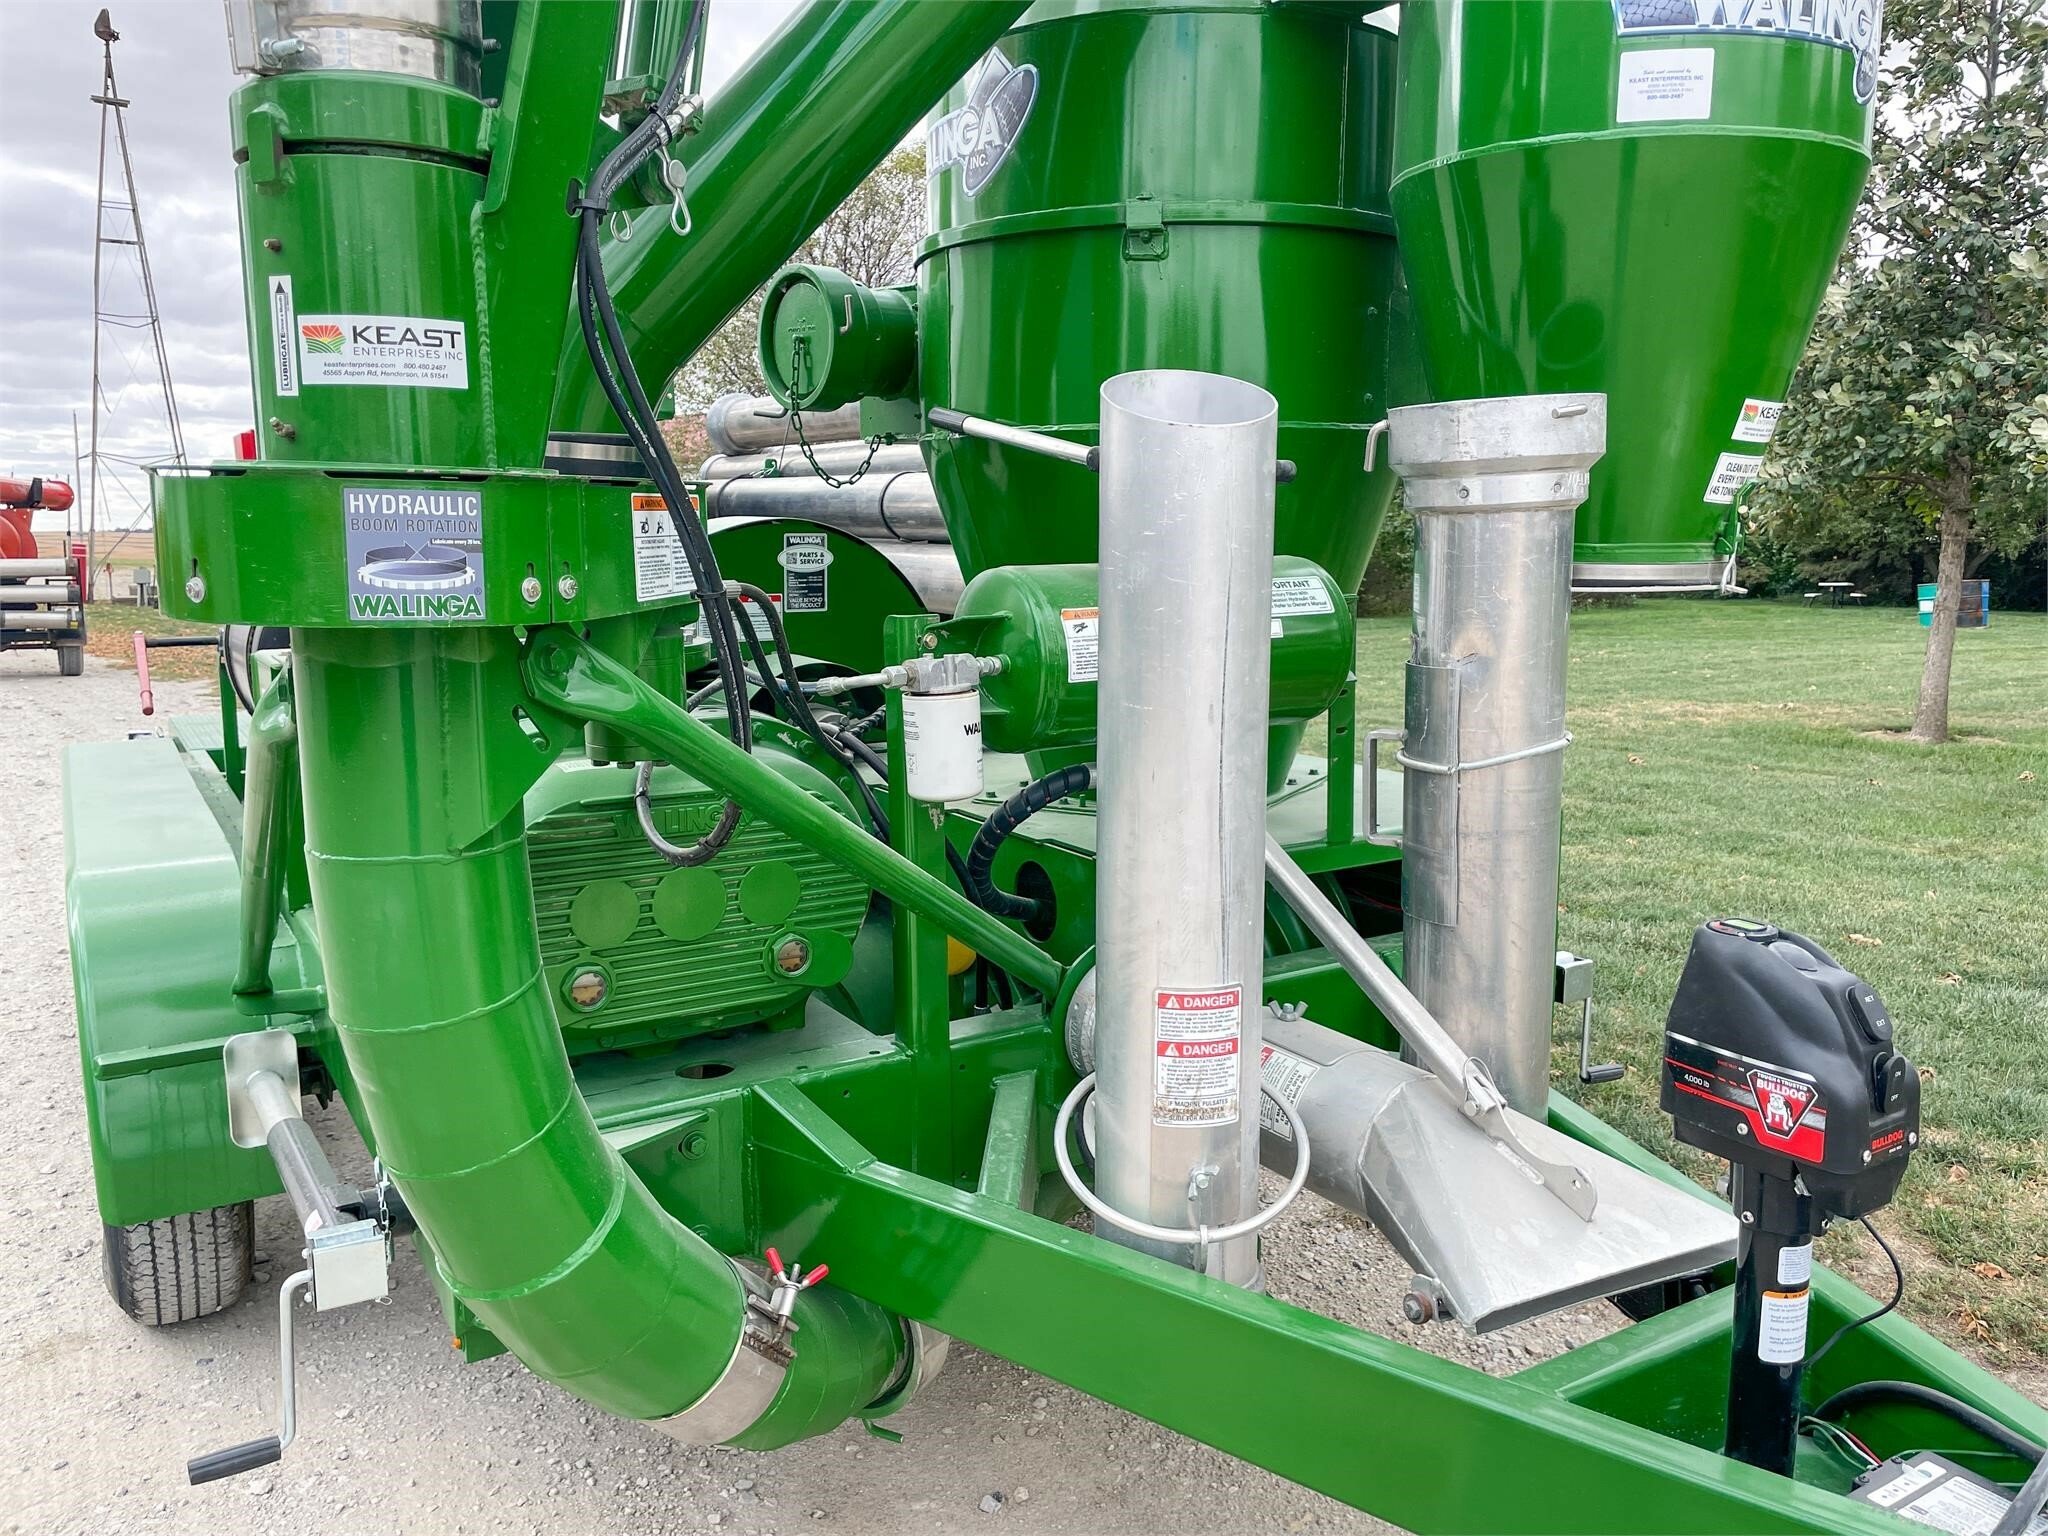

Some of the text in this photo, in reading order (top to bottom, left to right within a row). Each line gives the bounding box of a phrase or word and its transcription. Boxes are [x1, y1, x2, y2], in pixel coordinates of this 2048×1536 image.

[1694, 0, 1874, 50] WALING
[970, 153, 989, 170] INC.
[353, 325, 461, 349] KEAST
[280, 333, 289, 387] LUBRICATE
[353, 347, 463, 361] ENTERPRISES INC
[324, 361, 396, 369] keastenterprises.com
[343, 369, 365, 377] Aspen
[380, 371, 419, 379] Henderson,
[1760, 407, 1781, 419] KEAS
[1726, 462, 1742, 472] CLEAN
[1717, 474, 1734, 484] EVERY
[349, 493, 478, 516] HYDRAULIC
[351, 518, 478, 533] BOOM ROTATION
[352, 593, 483, 618] WALINGA
[1184, 995, 1234, 1008] DANGER
[1864, 994, 1874, 1002] RET
[1876, 1019, 1885, 1027] EXT
[1183, 1042, 1233, 1055] DANGER
[1684, 1074, 1702, 1085] 4,000
[1704, 1080, 1710, 1088] lb
[1895, 1070, 1901, 1078] ON
[1757, 1073, 1776, 1082] TOUGH
[1782, 1080, 1807, 1091] TRUSTED
[1757, 1078, 1806, 1101] BULLDOG
[1890, 1093, 1899, 1102] OFF
[1872, 1130, 1903, 1149] BULLDOG
